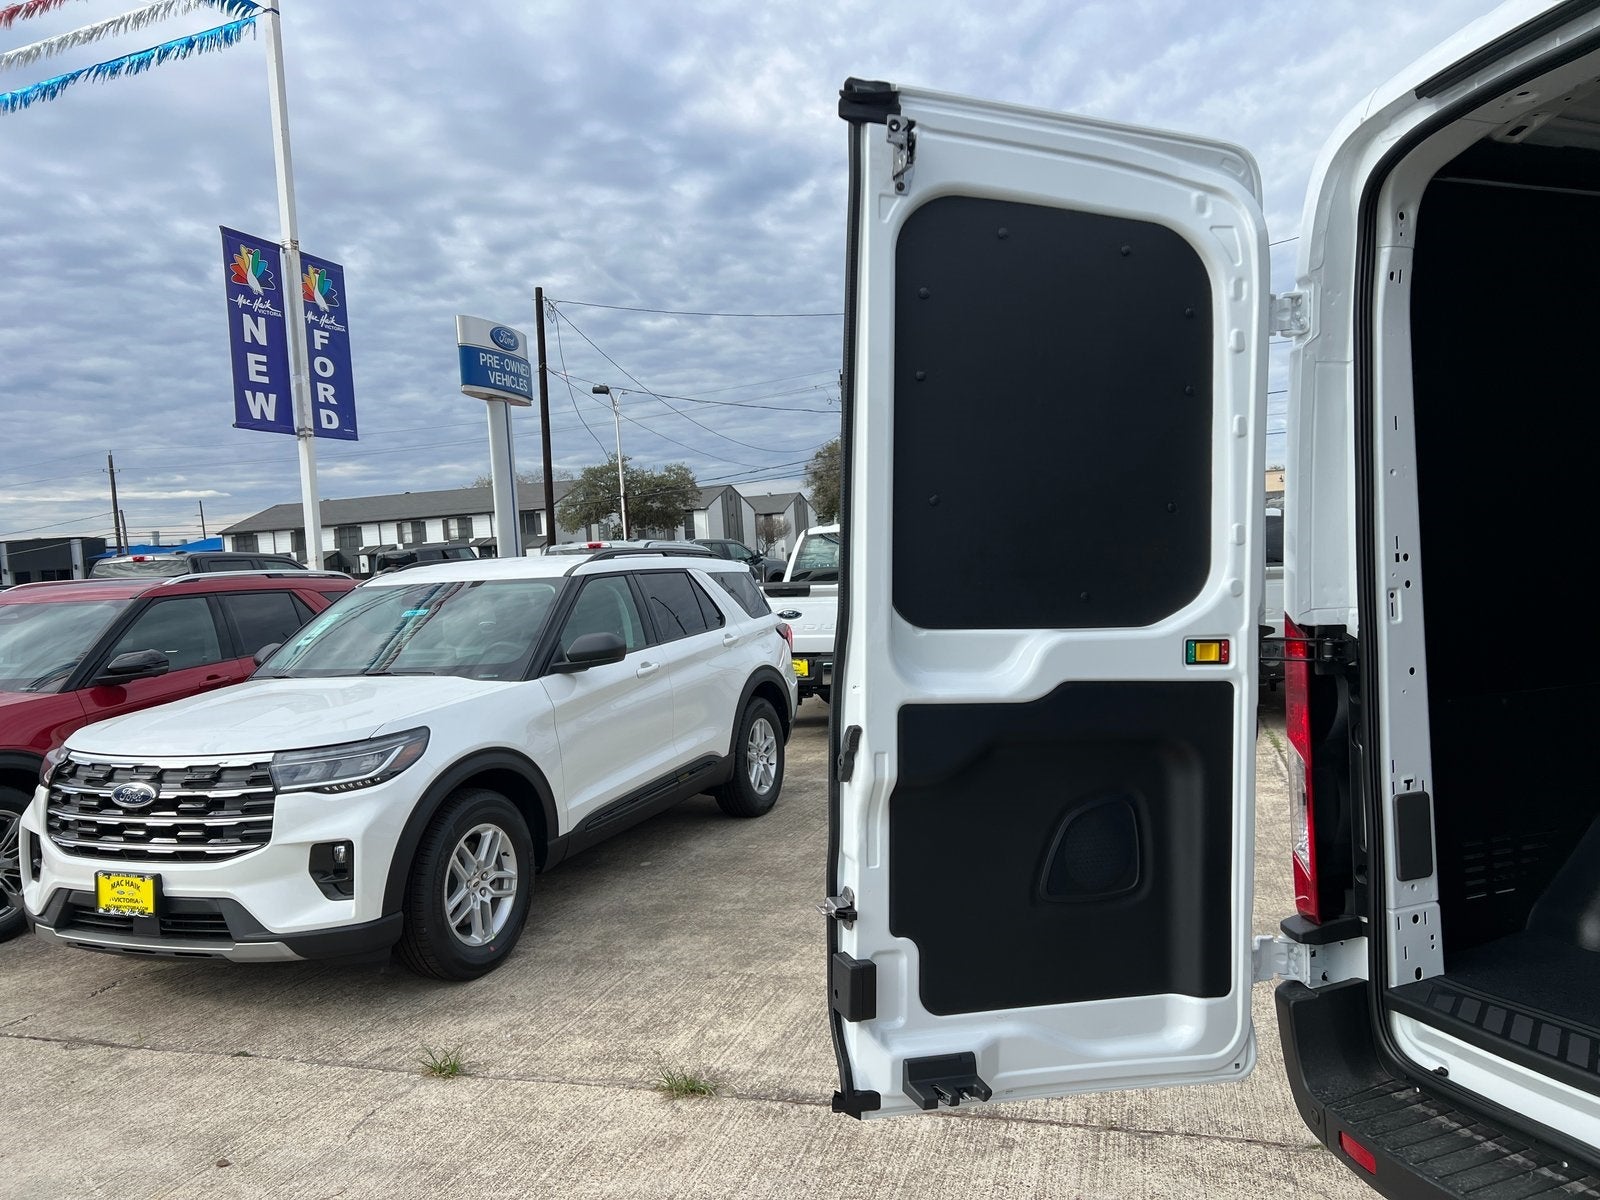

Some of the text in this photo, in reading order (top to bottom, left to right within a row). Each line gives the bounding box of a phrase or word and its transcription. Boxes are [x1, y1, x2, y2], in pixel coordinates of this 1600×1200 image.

[229, 293, 281, 312] Mac Haik
[258, 308, 282, 317] VICTORIA
[304, 310, 345, 328] Mac Haik
[324, 324, 346, 332] VICTORIA
[242, 313, 277, 422] NEW
[479, 352, 530, 378] PRE-OWNED
[313, 328, 340, 430] FORD
[488, 371, 528, 392] VEHICLES
[110, 879, 141, 892] MAC HAIK
